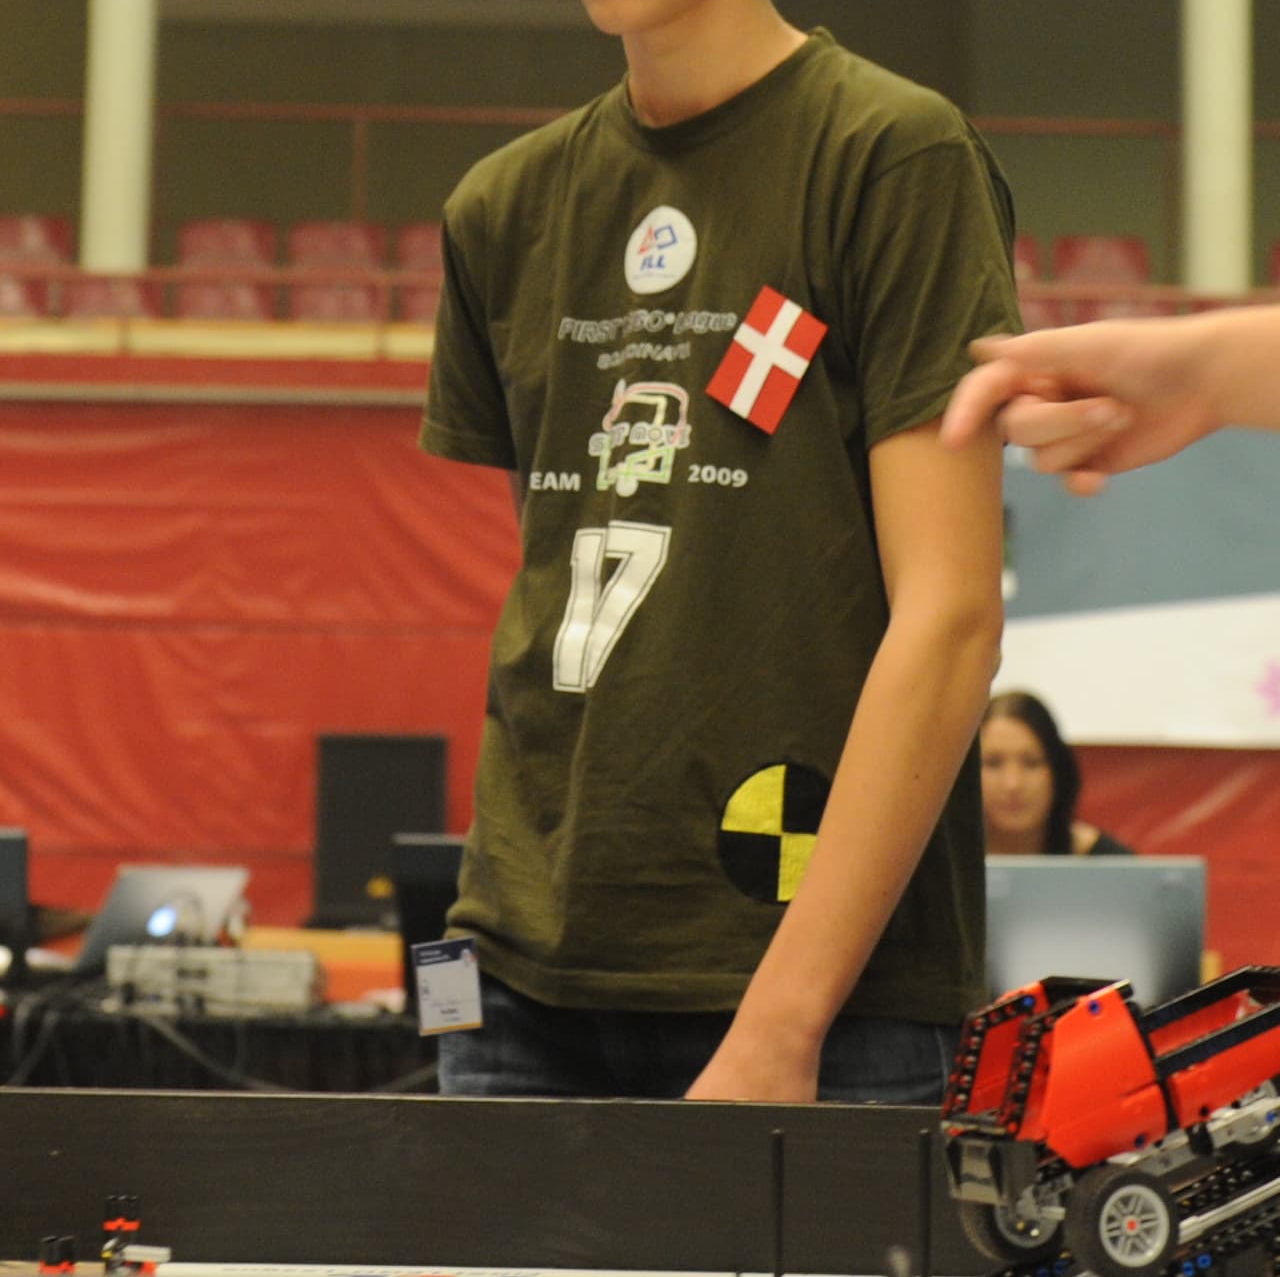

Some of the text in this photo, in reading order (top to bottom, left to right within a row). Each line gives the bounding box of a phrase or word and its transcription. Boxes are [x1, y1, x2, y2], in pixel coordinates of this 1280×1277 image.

[530, 465, 749, 491] EAM 2009
[553, 520, 672, 693] 17
